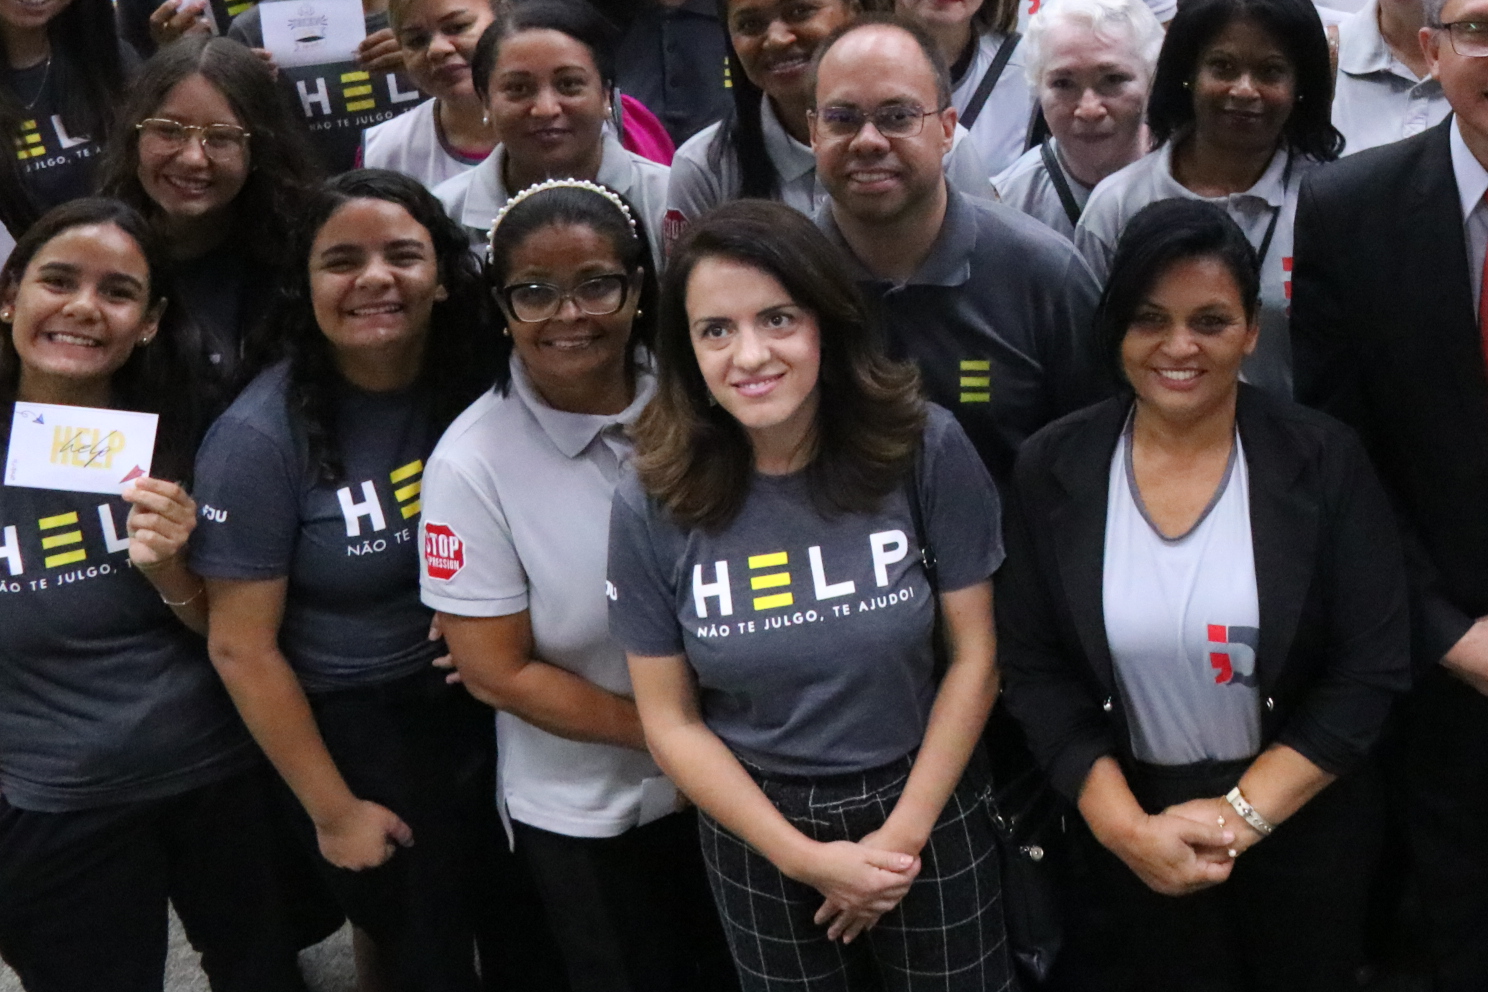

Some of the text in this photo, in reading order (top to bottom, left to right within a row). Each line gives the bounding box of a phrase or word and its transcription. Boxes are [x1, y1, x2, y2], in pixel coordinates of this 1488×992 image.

[296, 71, 419, 117] HEL
[17, 113, 92, 160] EL
[50, 425, 126, 469] HELP
[337, 459, 422, 537] HE
[0, 503, 129, 576] HEL
[347, 528, 410, 556] NÃO TE
[30, 578, 48, 592] TE
[692, 529, 909, 618] HELP
[697, 586, 914, 638] NÃO TE JULGO, TE AJUDO!
